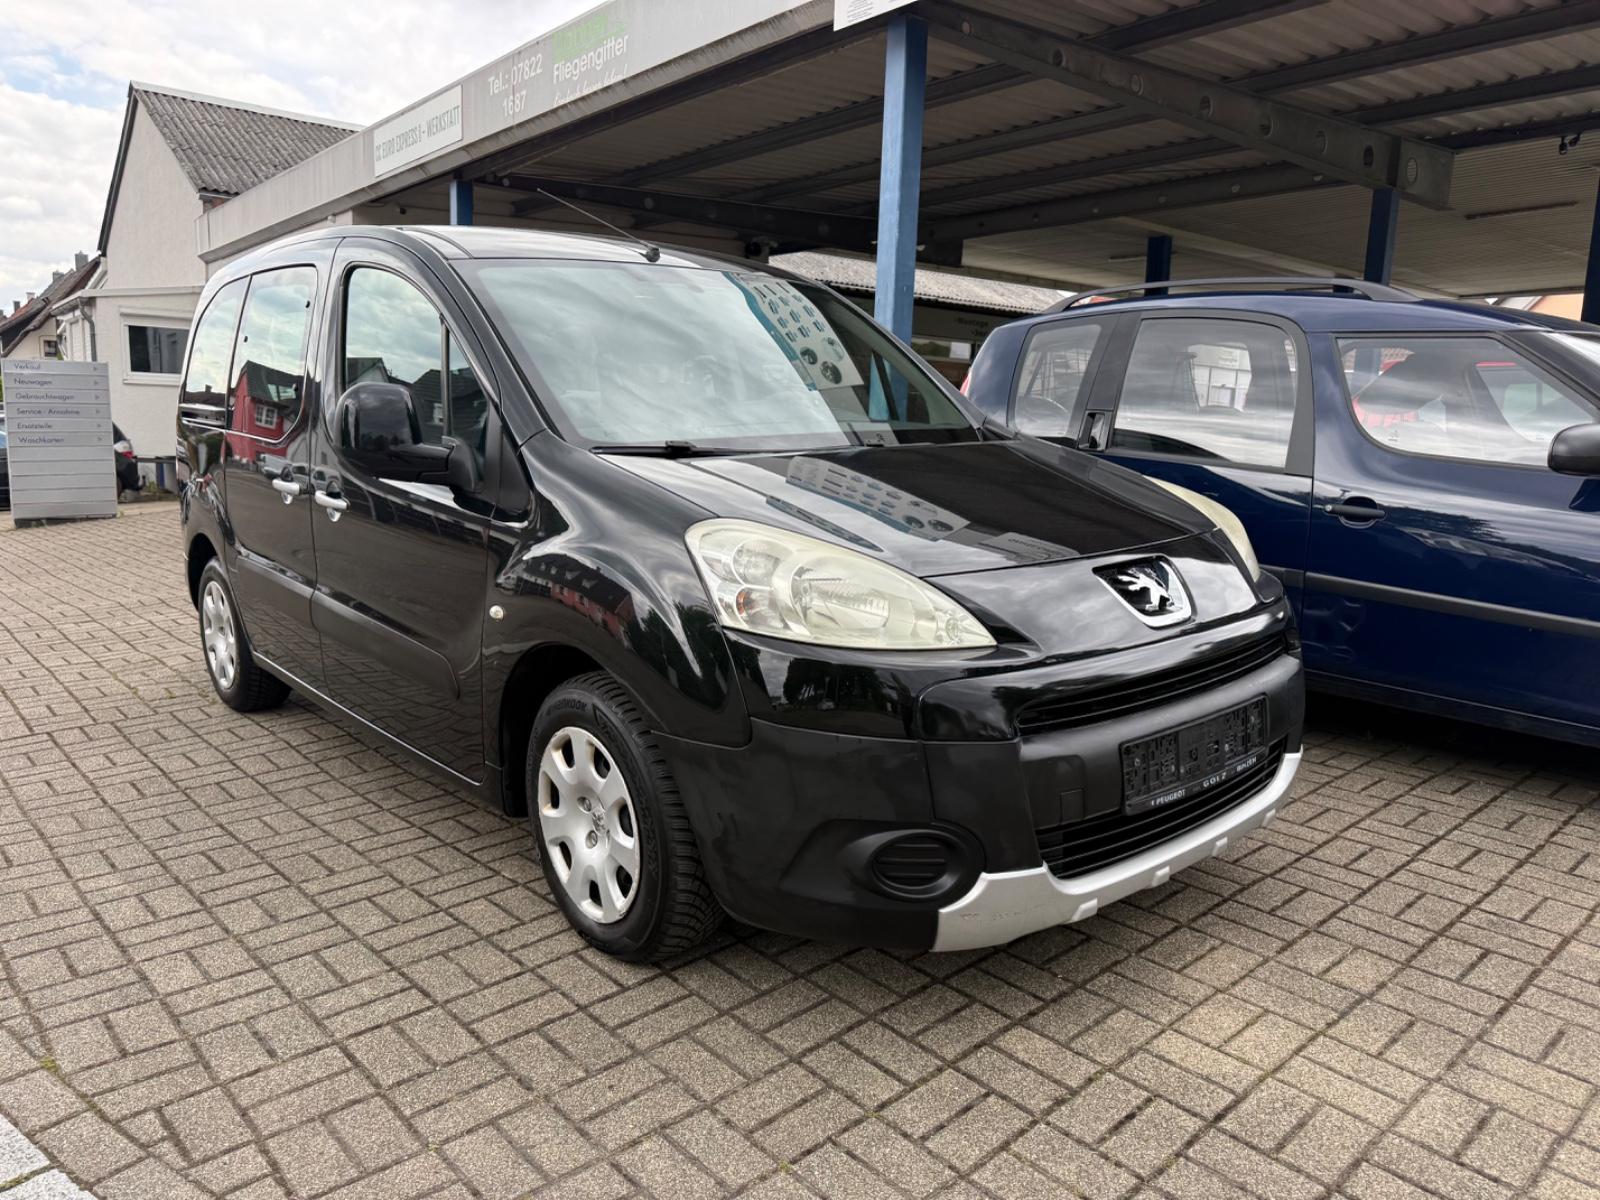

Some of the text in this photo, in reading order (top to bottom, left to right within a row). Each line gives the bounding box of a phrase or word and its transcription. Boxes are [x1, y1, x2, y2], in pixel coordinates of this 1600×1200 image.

[553, 35, 629, 84] Fliegengitter
[488, 53, 544, 96] Tel.: 07822
[502, 90, 527, 117] 1687
[426, 104, 461, 138] WERKSTATT
[14, 362, 41, 371] Verkauf
[14, 377, 53, 387] Neuwagen
[15, 392, 75, 402] Gebrauchtwagen
[16, 407, 41, 416] Service
[17, 422, 53, 430] Ersatzteile
[18, 436, 65, 444] Waschkarten
[1156, 789, 1186, 805] PEUGEOT
